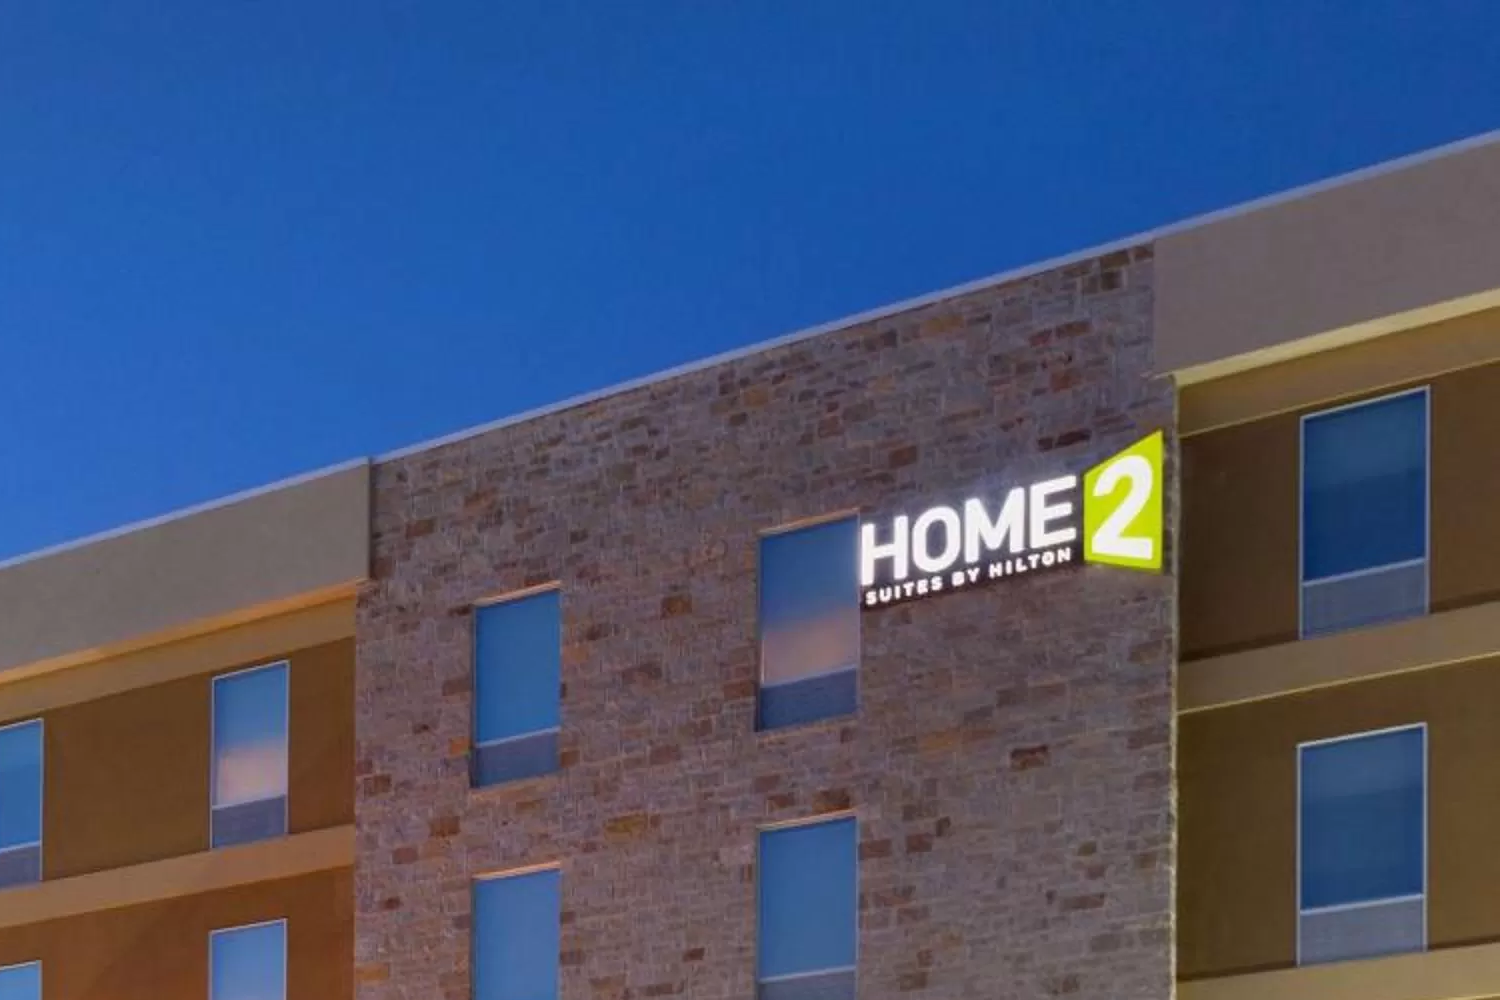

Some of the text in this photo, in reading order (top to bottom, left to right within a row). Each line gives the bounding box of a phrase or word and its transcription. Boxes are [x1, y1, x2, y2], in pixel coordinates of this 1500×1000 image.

[860, 454, 1154, 586] HOME 2
[865, 547, 1072, 606] SUITES BY HILTON
